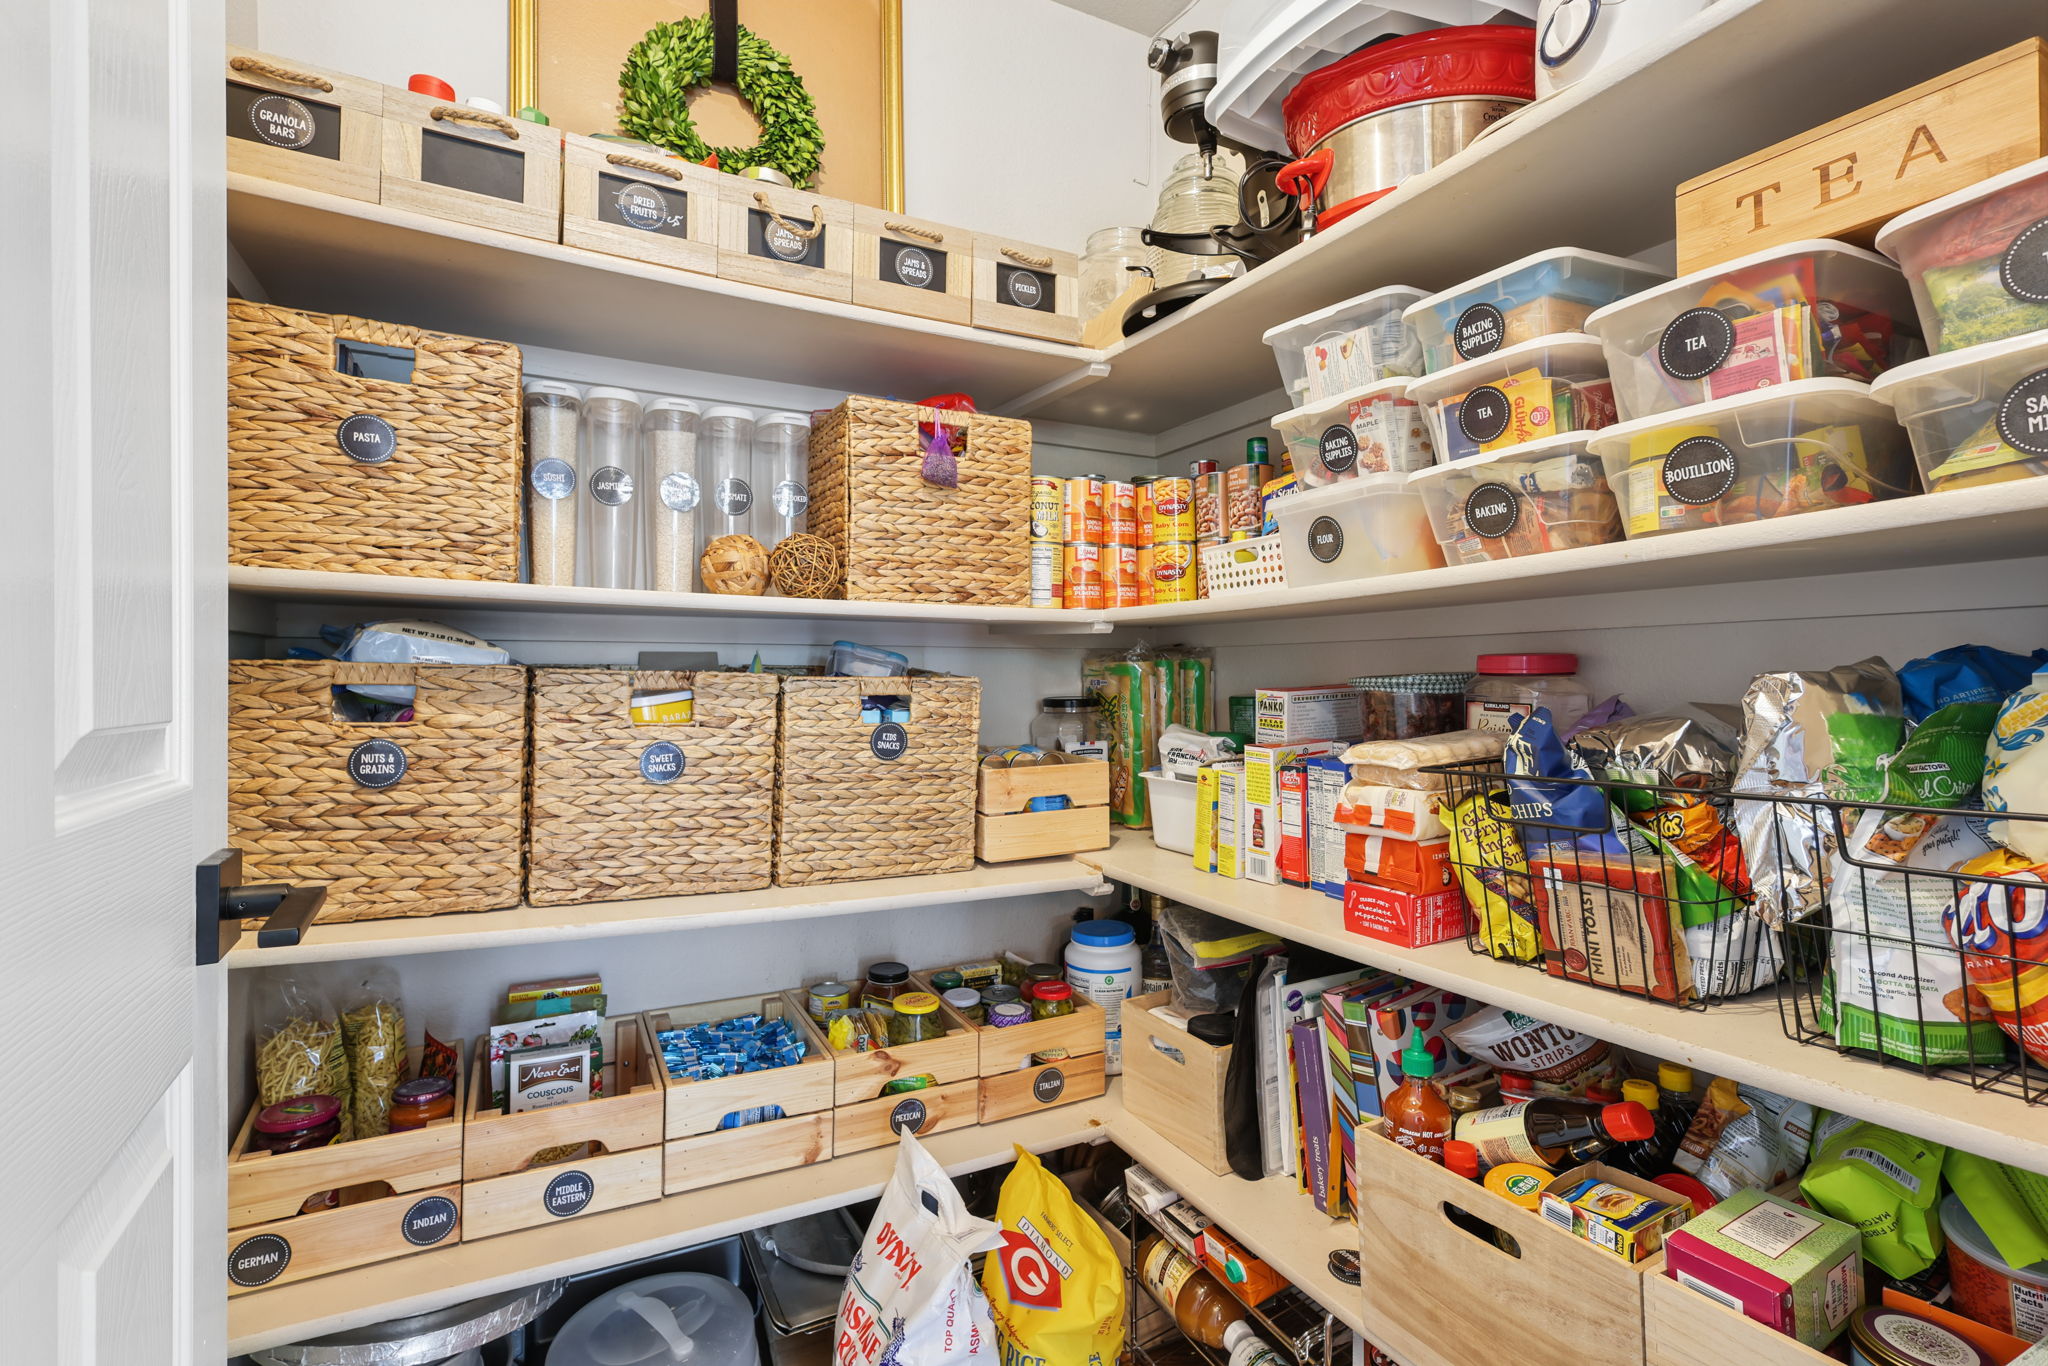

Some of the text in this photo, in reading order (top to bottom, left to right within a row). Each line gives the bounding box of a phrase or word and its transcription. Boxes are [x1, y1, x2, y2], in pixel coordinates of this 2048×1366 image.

[259, 108, 306, 131] GRANOLA
[269, 124, 295, 140] BARS
[1735, 124, 1950, 236] TEA
[633, 195, 656, 209] DRIED
[630, 205, 657, 219] FRUITS
[773, 237, 803, 251] SPREADS
[903, 258, 926, 269] JAMS &
[901, 266, 927, 279] SPREADS
[1015, 281, 1037, 295] PICKLES
[1462, 318, 1494, 337] BAKING
[1461, 330, 1498, 351] SUPPLIES
[1684, 335, 1708, 352] TEA
[1477, 407, 1493, 420] TEA
[1356, 419, 1379, 430] MAPLE
[353, 432, 381, 444] PASTA
[1325, 437, 1349, 450] BAKING
[1325, 446, 1353, 462] SUPPLIES
[543, 473, 566, 483] SUSHI
[1665, 457, 1733, 485] BOUILLION
[1037, 512, 1058, 521] MILK
[1475, 503, 1508, 519] BAKING
[1316, 533, 1334, 545] FLOUR
[402, 627, 416, 635] NET
[1260, 700, 1283, 712] PANKO
[1937, 696, 1950, 705] NO
[882, 732, 897, 742] KIDS
[877, 739, 900, 751] SNACKS
[361, 754, 395, 765] NUTS &
[650, 754, 673, 763] SWEET
[359, 763, 395, 776] GRAINS
[648, 763, 676, 773] SNACKS
[1463, 799, 1507, 827] GIANT
[1511, 802, 1553, 819] CHIPS
[1358, 904, 1392, 916] chocolate
[1355, 911, 1397, 925] peppermint
[1567, 930, 1576, 946] JOAN
[1582, 891, 1605, 975] MINI TOAST
[1870, 970, 1896, 980] econd
[1897, 973, 1936, 985] Appeizer:
[562, 985, 600, 997] NOUVEAU
[1876, 979, 1939, 994] BOTTA BURATA
[1488, 1022, 1582, 1063] WONTO
[1531, 1045, 1574, 1068] STRIPS
[522, 1063, 581, 1082] Near East
[1039, 1079, 1060, 1091] ITALIAN
[527, 1086, 574, 1100] COUSCOUS
[894, 1109, 922, 1123] MEXICAN
[1423, 1131, 1433, 1139] HOT
[1313, 1136, 1326, 1198] bakery treats
[555, 1183, 584, 1198] MIDDLE
[552, 1191, 587, 1207] EASTERN
[412, 1213, 447, 1230] INDIAN
[1055, 1228, 1074, 1248] SELECT
[1022, 1222, 1069, 1276] DIAMOND
[238, 1251, 279, 1270] GERMAN
[1841, 1264, 1850, 1316] MOROCCAN
[2015, 1294, 2044, 1309] Facts
[2017, 1319, 2044, 1331] Calories
